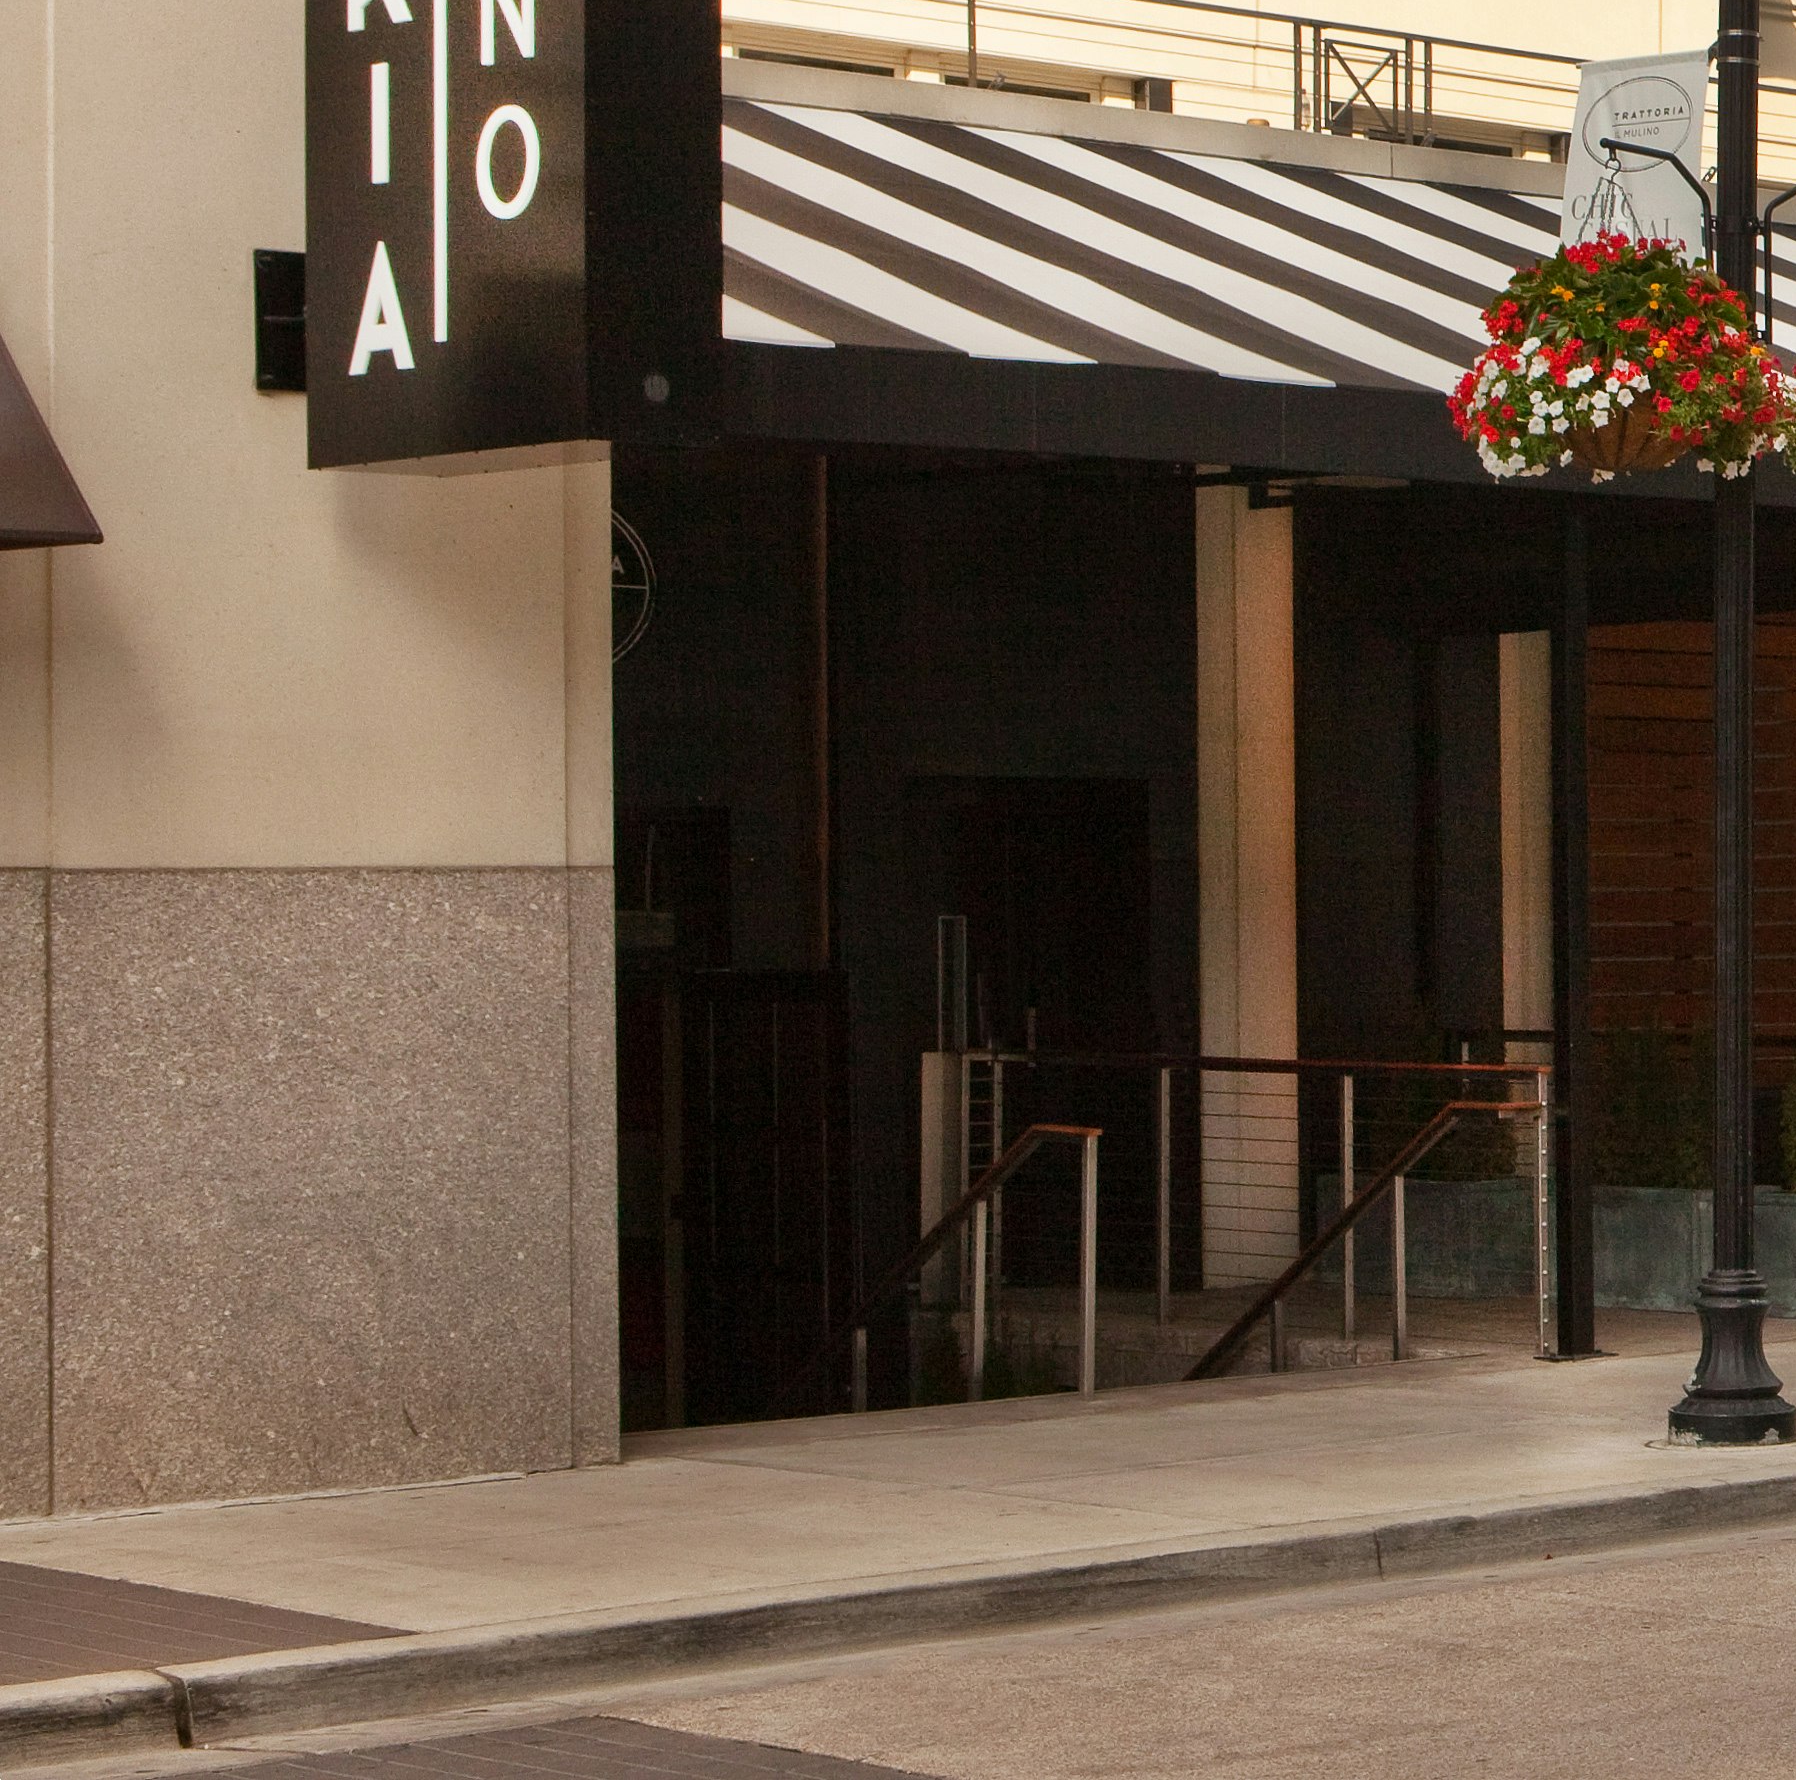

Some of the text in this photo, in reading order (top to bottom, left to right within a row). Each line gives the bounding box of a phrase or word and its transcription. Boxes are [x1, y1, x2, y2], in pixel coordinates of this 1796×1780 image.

[1614, 106, 1684, 121] TRATTORIA
[1623, 126, 1660, 138] MULINO
[1571, 192, 1633, 221] CHIC
